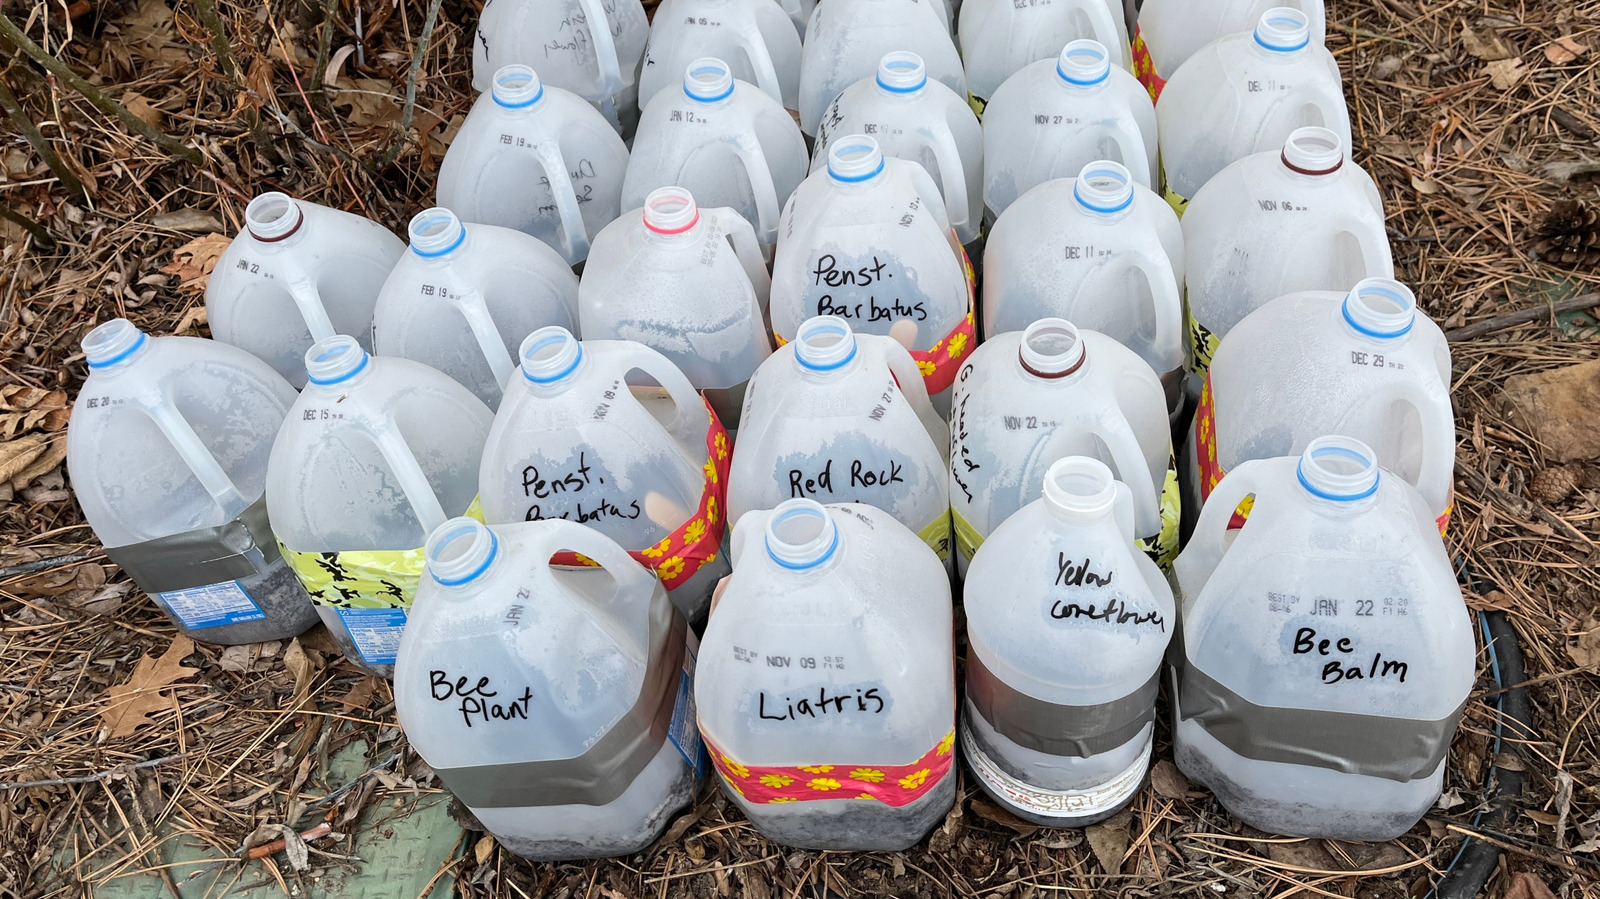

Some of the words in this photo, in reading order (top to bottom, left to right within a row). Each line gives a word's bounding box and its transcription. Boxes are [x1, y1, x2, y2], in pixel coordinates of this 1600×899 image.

[698, 17, 708, 26] 05
[670, 109, 682, 122] JAN
[686, 111, 694, 122] 12
[1034, 114, 1049, 125] NOV
[1053, 115, 1063, 125] 27
[864, 123, 878, 134] DEC
[500, 133, 513, 145] FEB
[516, 137, 525, 147] 19
[1259, 199, 1278, 212] NOV
[1282, 200, 1293, 211] 06
[1065, 245, 1080, 260] DEC
[1085, 245, 1094, 258] 11
[236, 257, 248, 272] JAN
[250, 262, 259, 275] 22
[813, 254, 893, 287] Penst.
[421, 283, 434, 296] FEB
[438, 286, 447, 298] 19
[817, 294, 928, 322] Barbatus
[1351, 350, 1369, 366] DEC
[1373, 353, 1385, 368] 29
[87, 396, 99, 409] DEC
[101, 395, 110, 407] 20
[868, 403, 887, 422] NOV
[881, 391, 893, 404] 27
[303, 408, 316, 421] DEC
[320, 408, 329, 420] 15
[1004, 415, 1021, 430] NOV
[1026, 415, 1038, 429] 22
[522, 451, 604, 498] Penst.
[788, 459, 833, 498] Red
[851, 459, 904, 487] Rock
[1055, 551, 1113, 587] Yellow
[1268, 592, 1288, 604] BEST
[1310, 599, 1339, 616] JAN
[1355, 599, 1374, 617] 22
[503, 603, 524, 627] JAN
[1293, 627, 1354, 656] Bee
[766, 655, 791, 668] NOV
[800, 657, 816, 669] 09
[1321, 652, 1408, 684] Balm
[429, 669, 498, 701] Bee
[759, 687, 884, 721] Liatris
